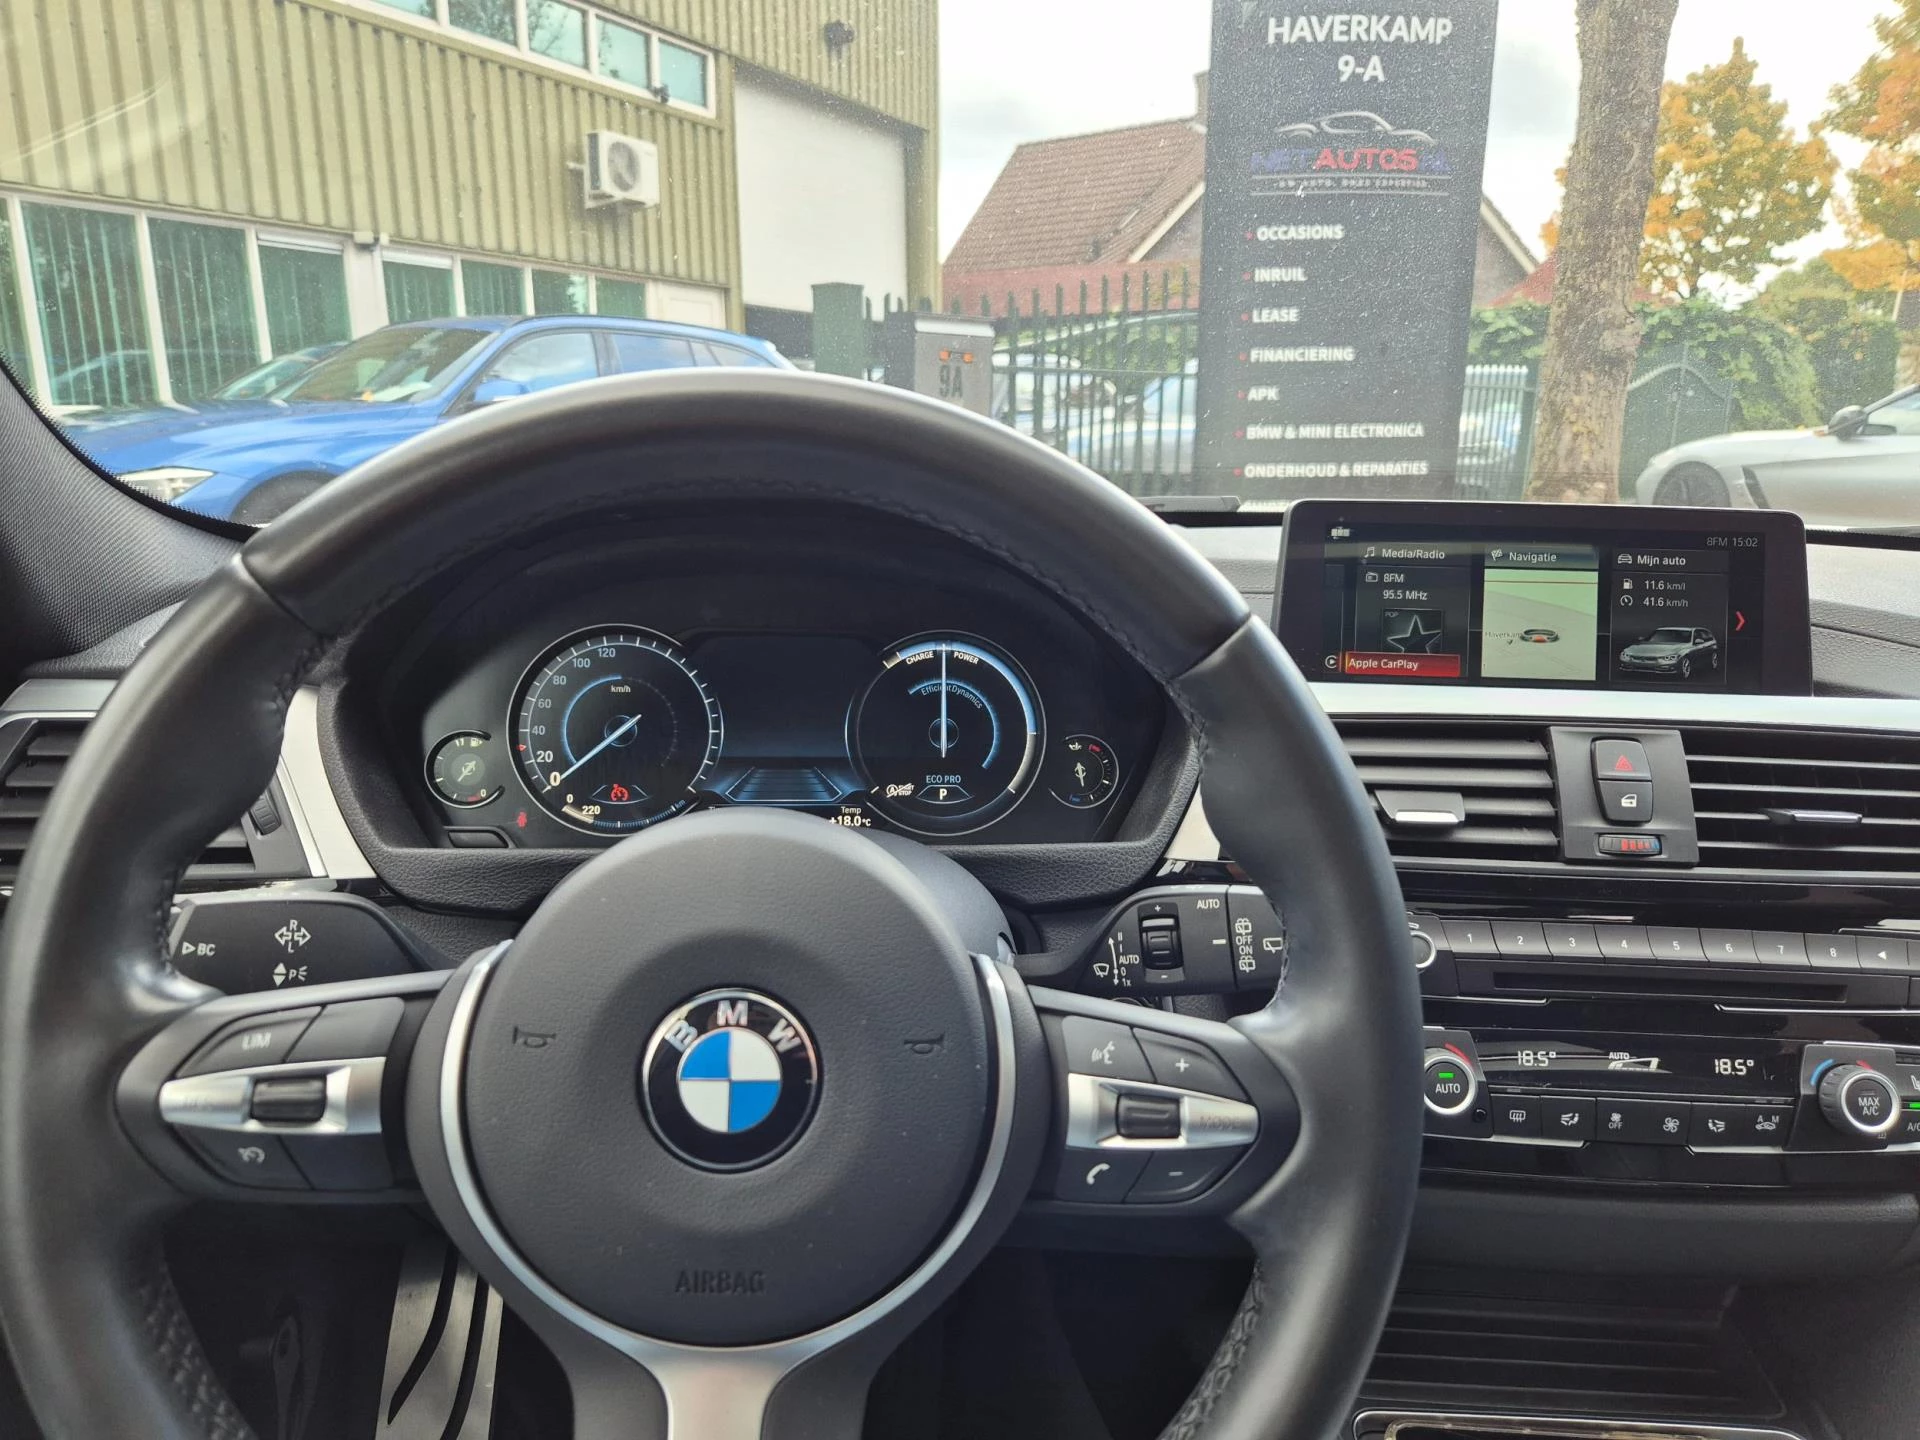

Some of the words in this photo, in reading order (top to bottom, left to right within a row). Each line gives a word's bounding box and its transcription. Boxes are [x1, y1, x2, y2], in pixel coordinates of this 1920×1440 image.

[1267, 14, 1453, 44] HAVERKAMP
[1337, 55, 1385, 83] 9-A
[1256, 224, 1345, 241] OCCASIONS
[1254, 267, 1308, 282] INRUIL
[1252, 306, 1300, 323] LEASE
[1250, 346, 1356, 362] FINANCIERING
[1248, 385, 1280, 401] APK
[1246, 424, 1283, 440] BMW
[1284, 424, 1298, 439] &
[1299, 424, 1332, 439] MINI
[1334, 422, 1425, 439] ELECTRONICA
[1244, 463, 1337, 478] ONDERHOUD
[1339, 462, 1352, 477] &
[1353, 460, 1430, 476] REPARATIES
[1732, 537, 1758, 547] 15:02
[1382, 548, 1445, 560] Media/Radio
[1509, 551, 1557, 563] Navigatie
[1637, 555, 1660, 567] Mijn
[1662, 556, 1686, 566] auto
[1644, 580, 1665, 590] 11.6
[1383, 590, 1403, 600] 95.5
[1405, 591, 1427, 600] MHz
[1643, 597, 1664, 607] 41.6
[1666, 598, 1689, 608] km/h
[597, 647, 616, 659] 120
[905, 651, 934, 665] CHARGE
[953, 651, 979, 665] POWER
[572, 657, 591, 669] 100
[1348, 658, 1378, 669] Apple
[1381, 659, 1419, 671] CarPlay
[552, 675, 567, 686] 80
[610, 684, 631, 694] km/h
[538, 698, 552, 709] 60
[532, 725, 546, 736] 40
[536, 750, 554, 763] 20
[549, 771, 561, 786] 0
[926, 775, 942, 784] ECO
[944, 775, 961, 784] PRO
[939, 788, 948, 800] P
[582, 805, 601, 815] 220
[840, 806, 862, 815] Temp
[1197, 899, 1220, 909] AUTO
[1235, 936, 1253, 946] OFF
[1467, 934, 1473, 943] 1
[1517, 936, 1524, 945] 2
[1569, 938, 1576, 947] 3
[1621, 940, 1628, 949] 4
[1673, 941, 1680, 951] 5
[1726, 943, 1733, 953] 6
[1777, 945, 1784, 955] 7
[1829, 947, 1837, 957] 8
[197, 943, 216, 956] BC
[1239, 946, 1253, 955] ON
[1119, 955, 1140, 964] AUTO
[664, 1000, 802, 1053] BMW
[241, 1032, 272, 1050] LIM
[1608, 1052, 1630, 1060] AUTO
[1435, 1083, 1461, 1094] AUTO
[1858, 1097, 1881, 1107] MAX
[1862, 1106, 1880, 1116] A/C
[1608, 1121, 1624, 1130] OFF
[674, 1269, 767, 1294] AIRBAG
